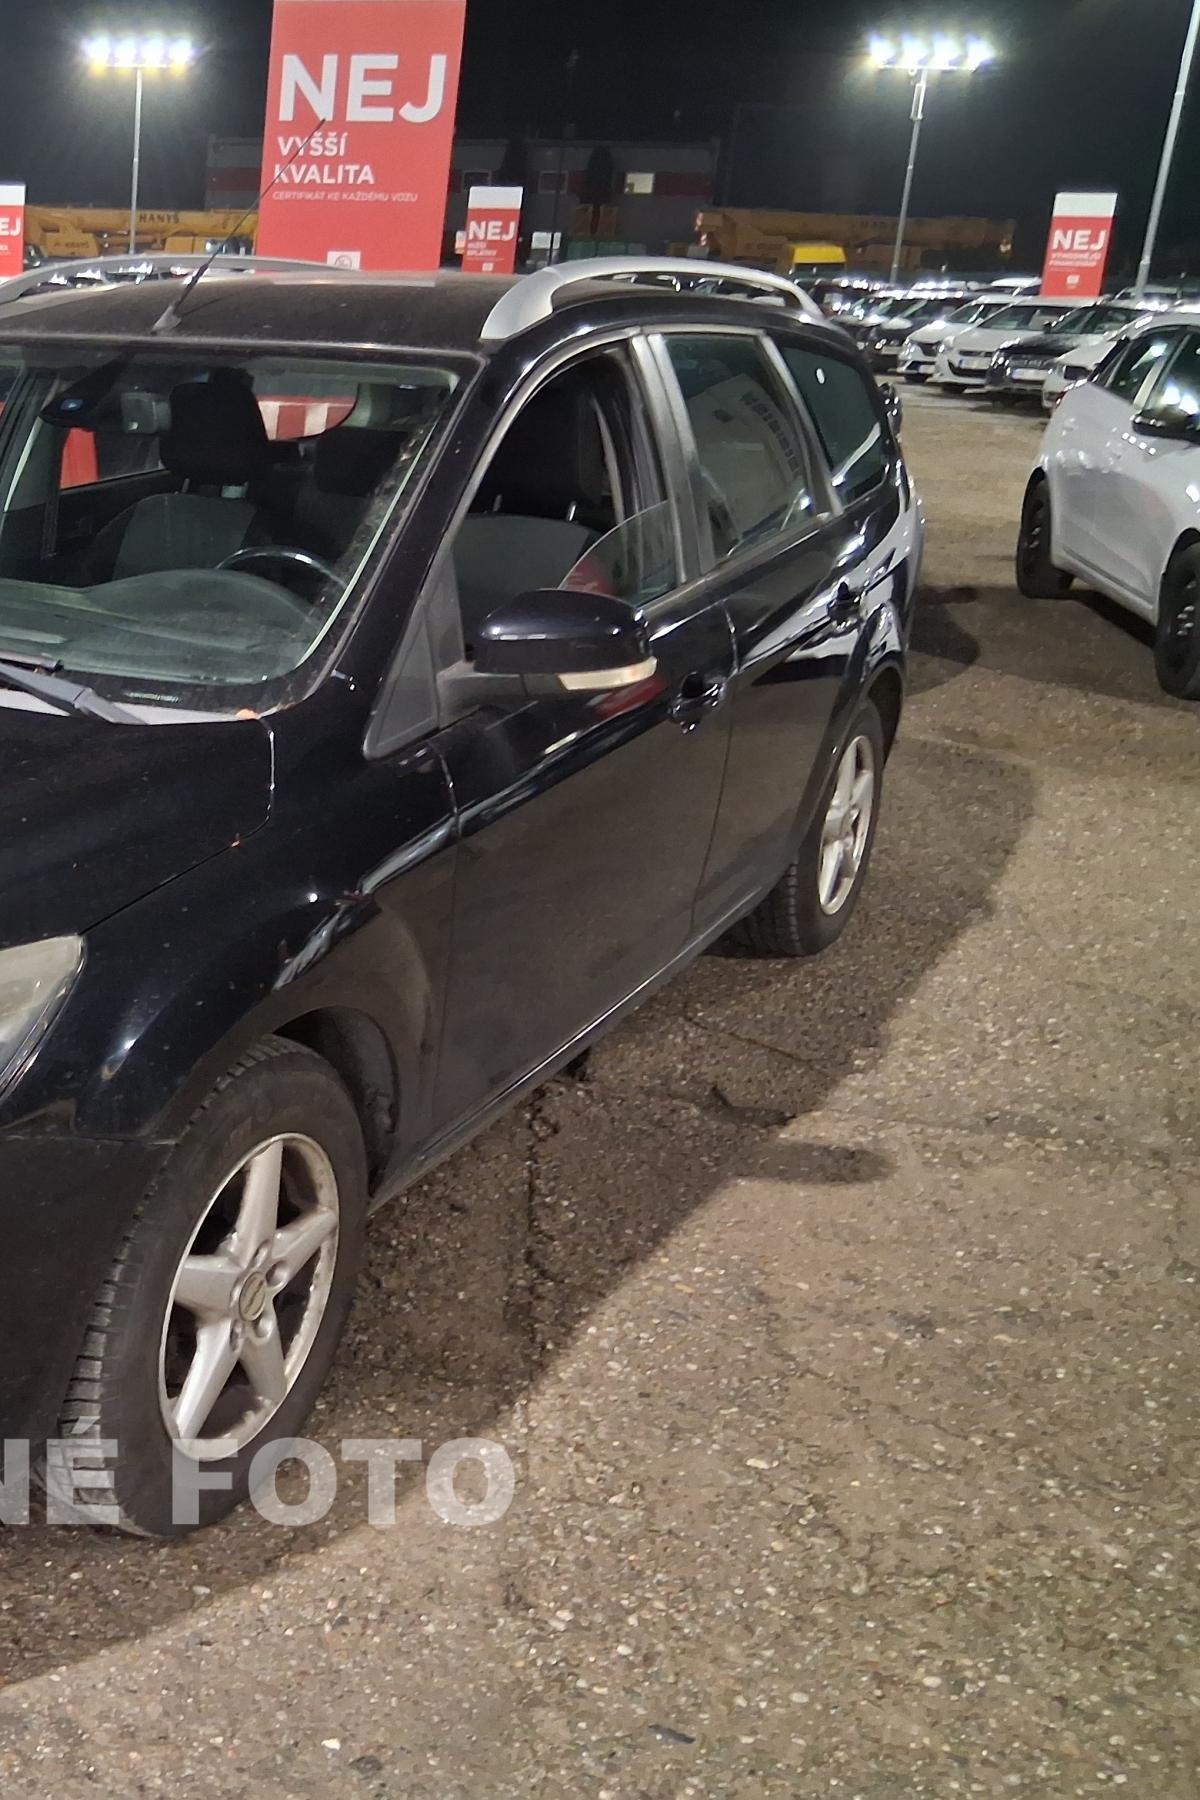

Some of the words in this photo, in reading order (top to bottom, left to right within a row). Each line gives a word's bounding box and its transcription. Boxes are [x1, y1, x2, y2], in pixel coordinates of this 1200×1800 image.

[279, 54, 447, 123] NEJ
[277, 131, 348, 157] VYŠŠÍ
[273, 163, 375, 185] KVALITA
[327, 191, 339, 201] KE
[468, 220, 515, 241] NEJ
[1052, 229, 1106, 250] NEJ
